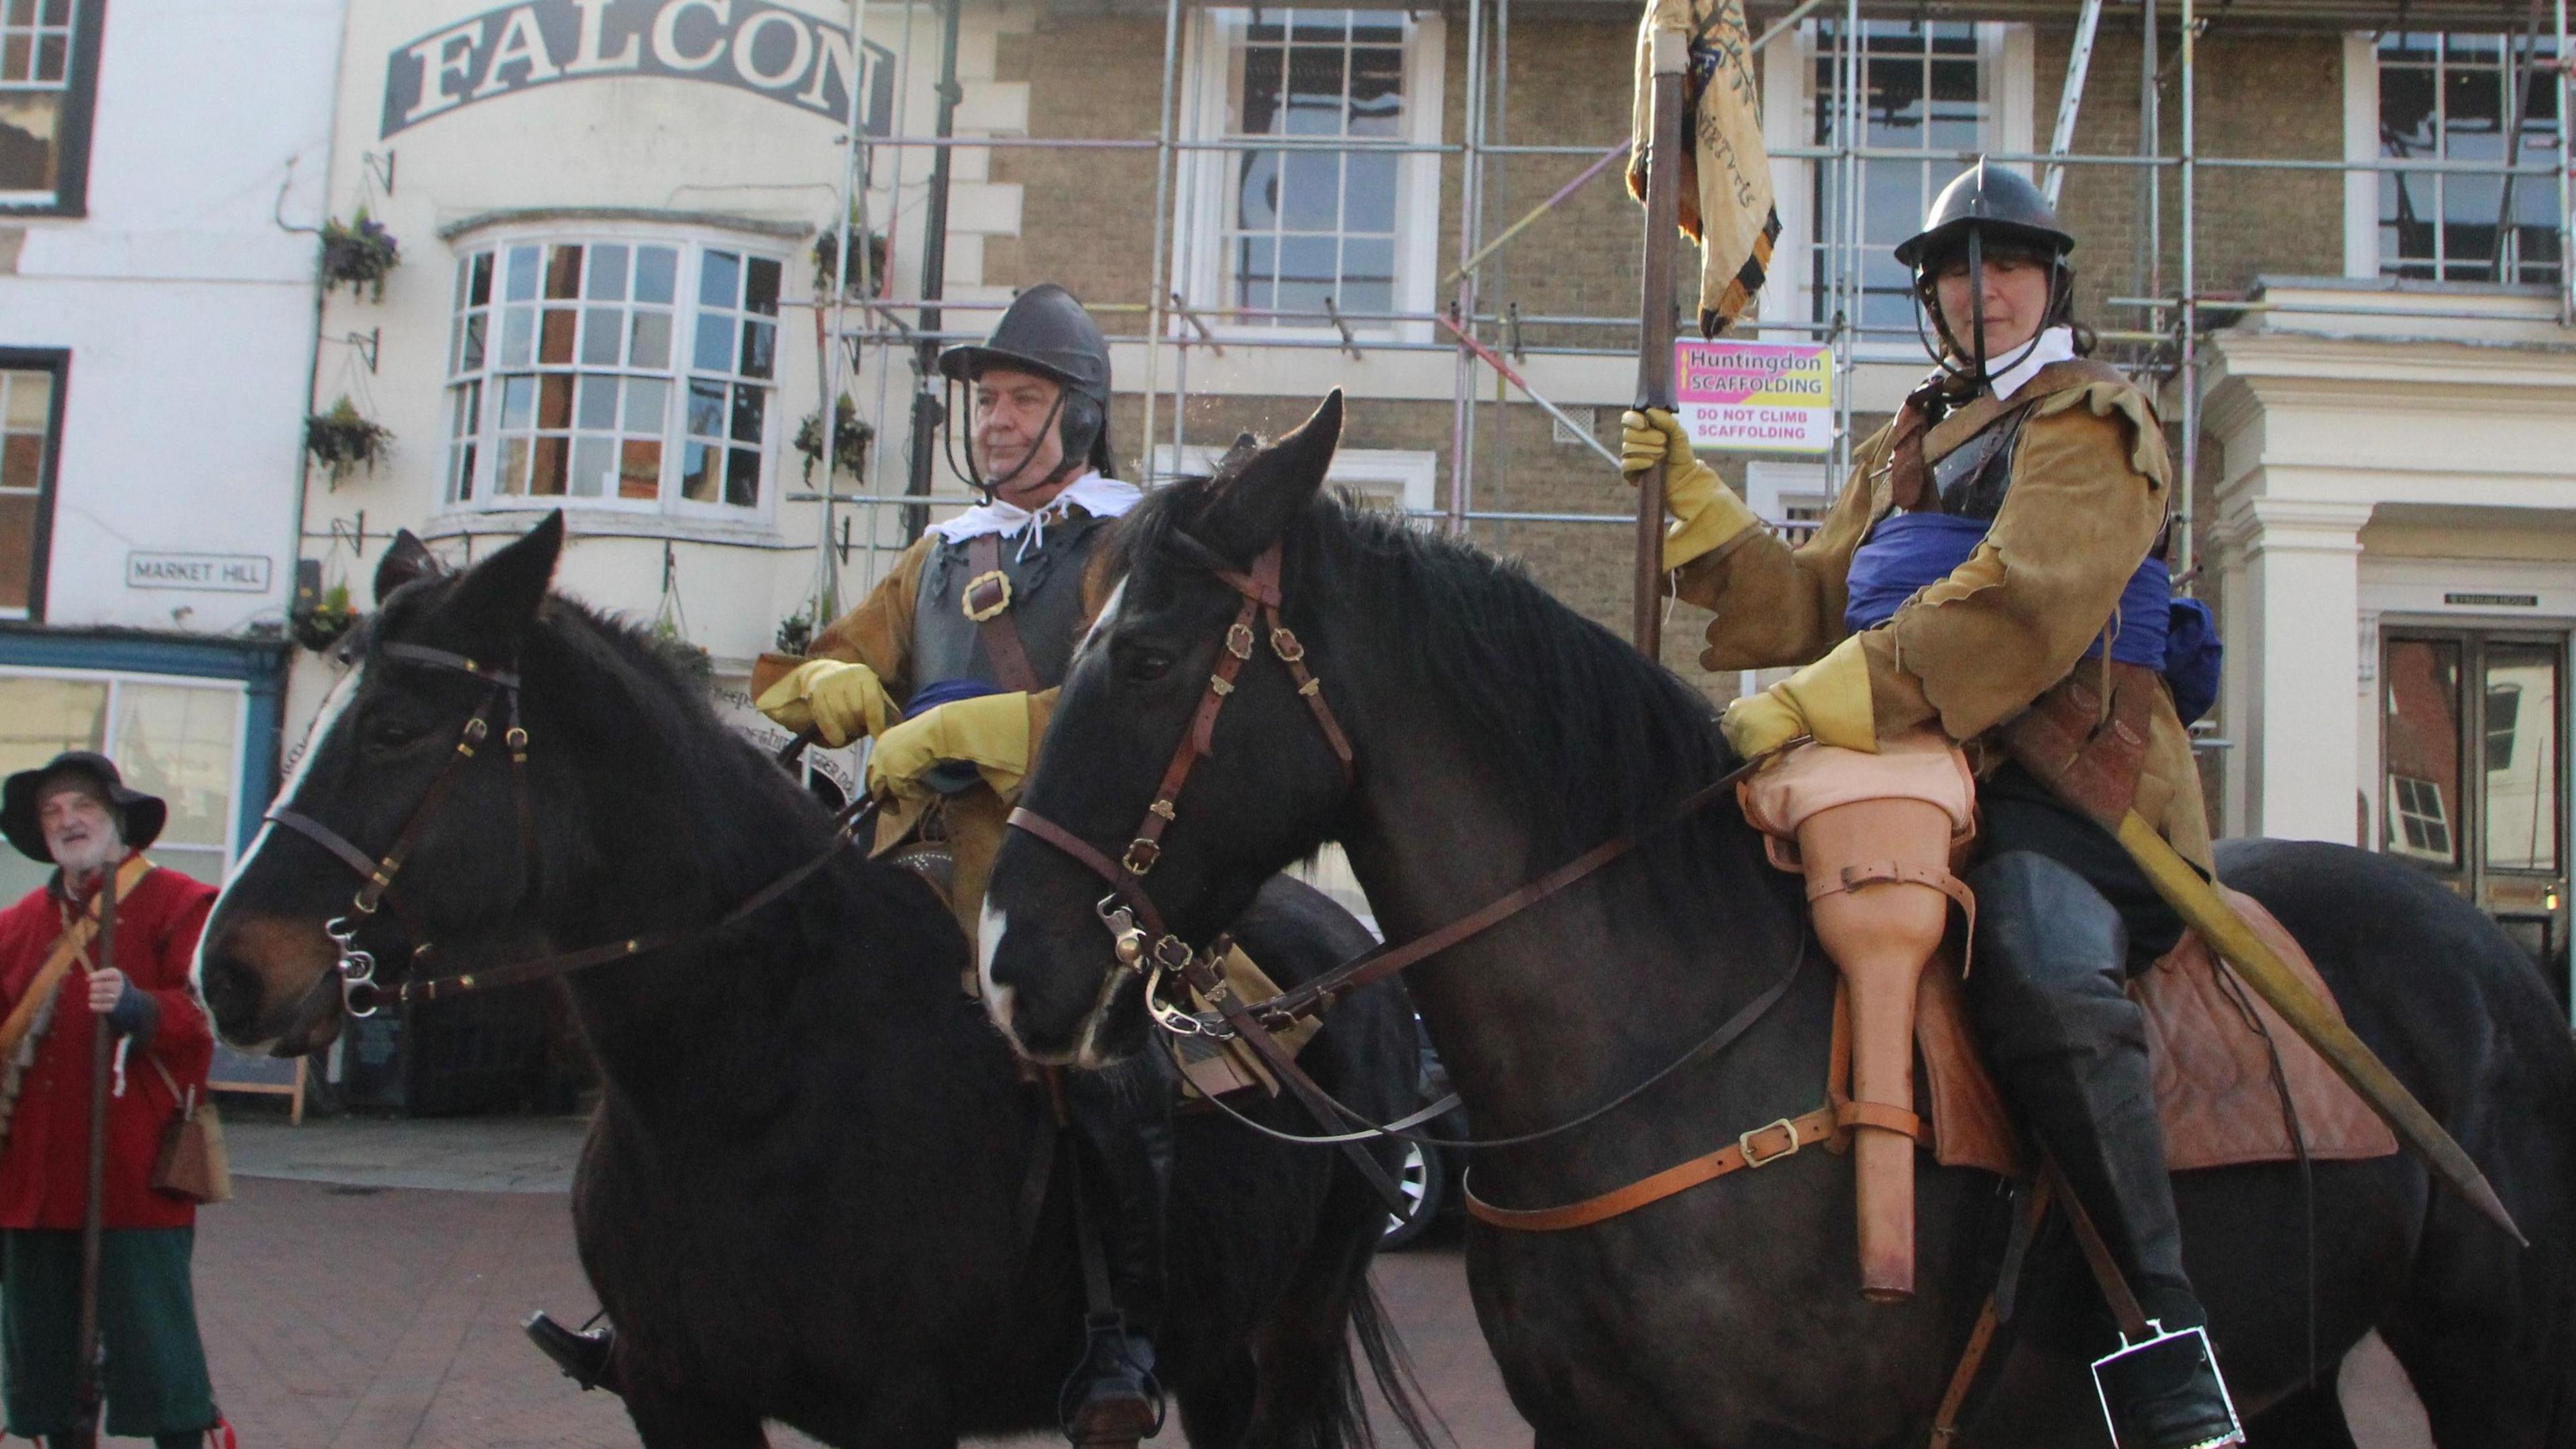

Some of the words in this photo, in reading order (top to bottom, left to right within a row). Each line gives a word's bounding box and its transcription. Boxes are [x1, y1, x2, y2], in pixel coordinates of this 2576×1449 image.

[405, 0, 882, 125] FALCON
[1690, 350, 1821, 374] Huntingdon
[1691, 374, 1822, 394] SCAFFOLDING
[1697, 409, 1718, 421] DO
[1723, 409, 1756, 422] NOT
[1760, 411, 1808, 423] CLIMB
[1698, 424, 1806, 439] SCAFFOLDING
[135, 561, 213, 581] MARKET
[223, 564, 258, 583] HILL
